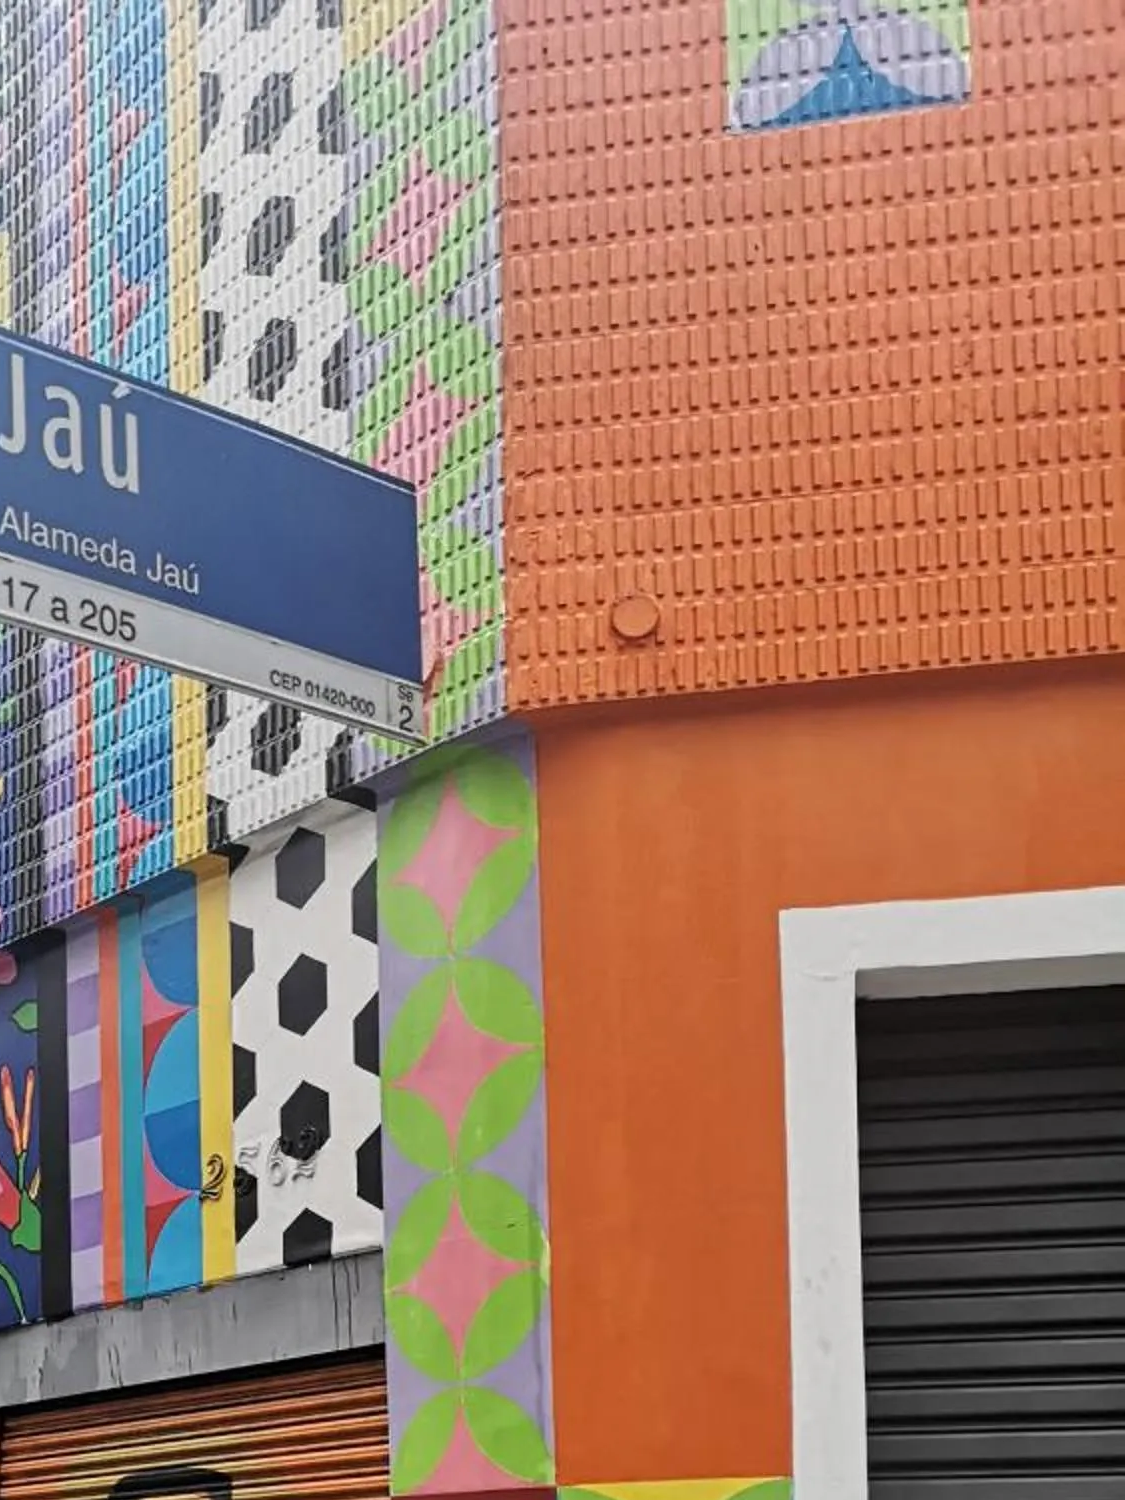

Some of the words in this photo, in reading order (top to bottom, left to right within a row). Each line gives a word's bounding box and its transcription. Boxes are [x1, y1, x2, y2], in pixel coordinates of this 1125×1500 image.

[0, 506, 137, 576] Alameda
[147, 550, 200, 595] Jaú
[1, 576, 41, 613] 17
[50, 603, 69, 625] a
[79, 599, 137, 641] 205
[269, 669, 302, 692] CEP
[304, 679, 376, 717] 01420-000
[398, 705, 414, 732] 2
